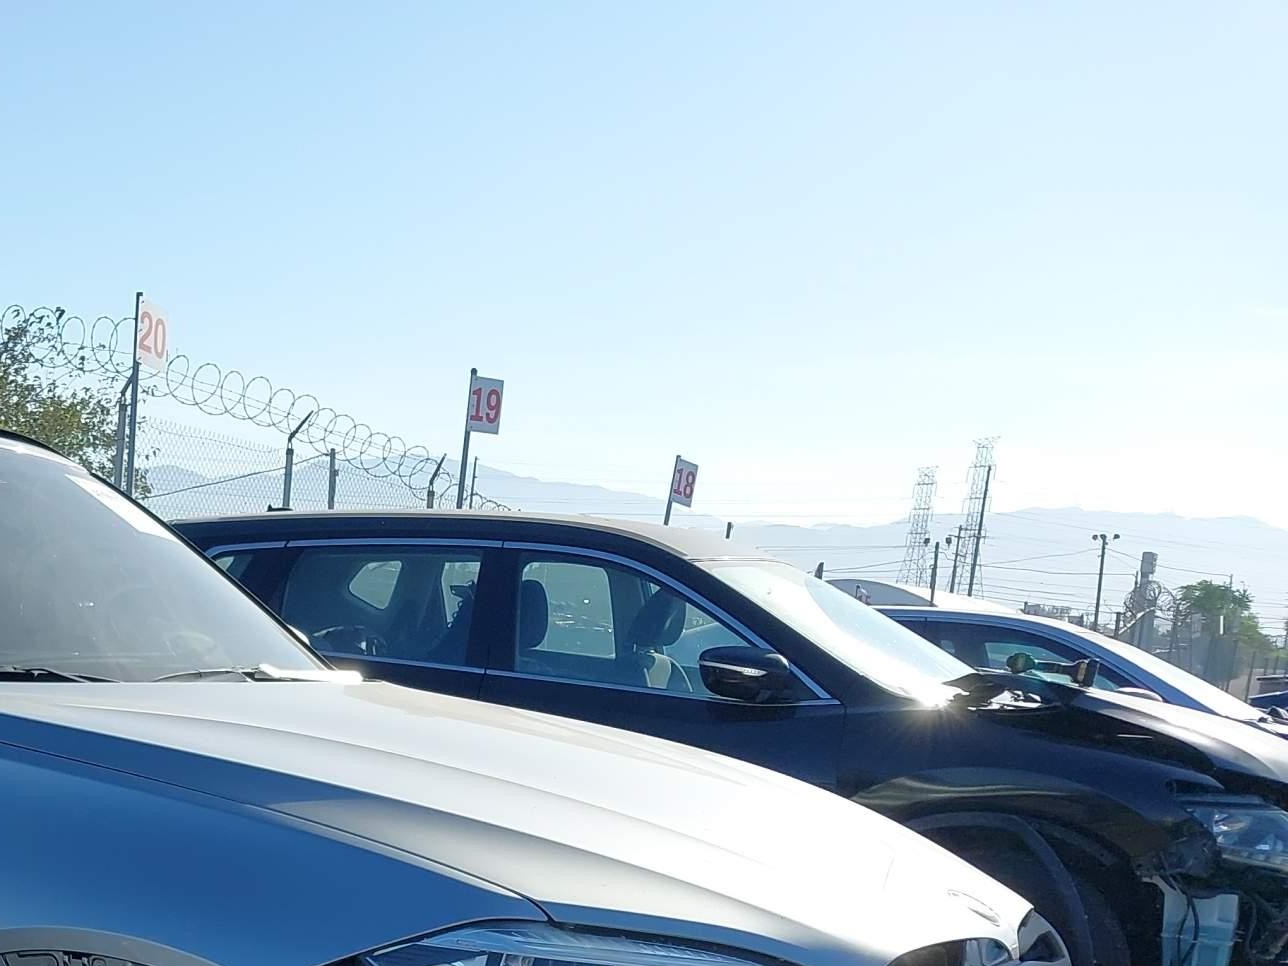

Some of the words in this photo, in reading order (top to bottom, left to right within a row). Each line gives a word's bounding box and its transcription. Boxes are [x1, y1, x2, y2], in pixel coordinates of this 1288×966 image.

[139, 311, 166, 359] 20
[470, 387, 500, 424] 19
[673, 468, 695, 498] 18
